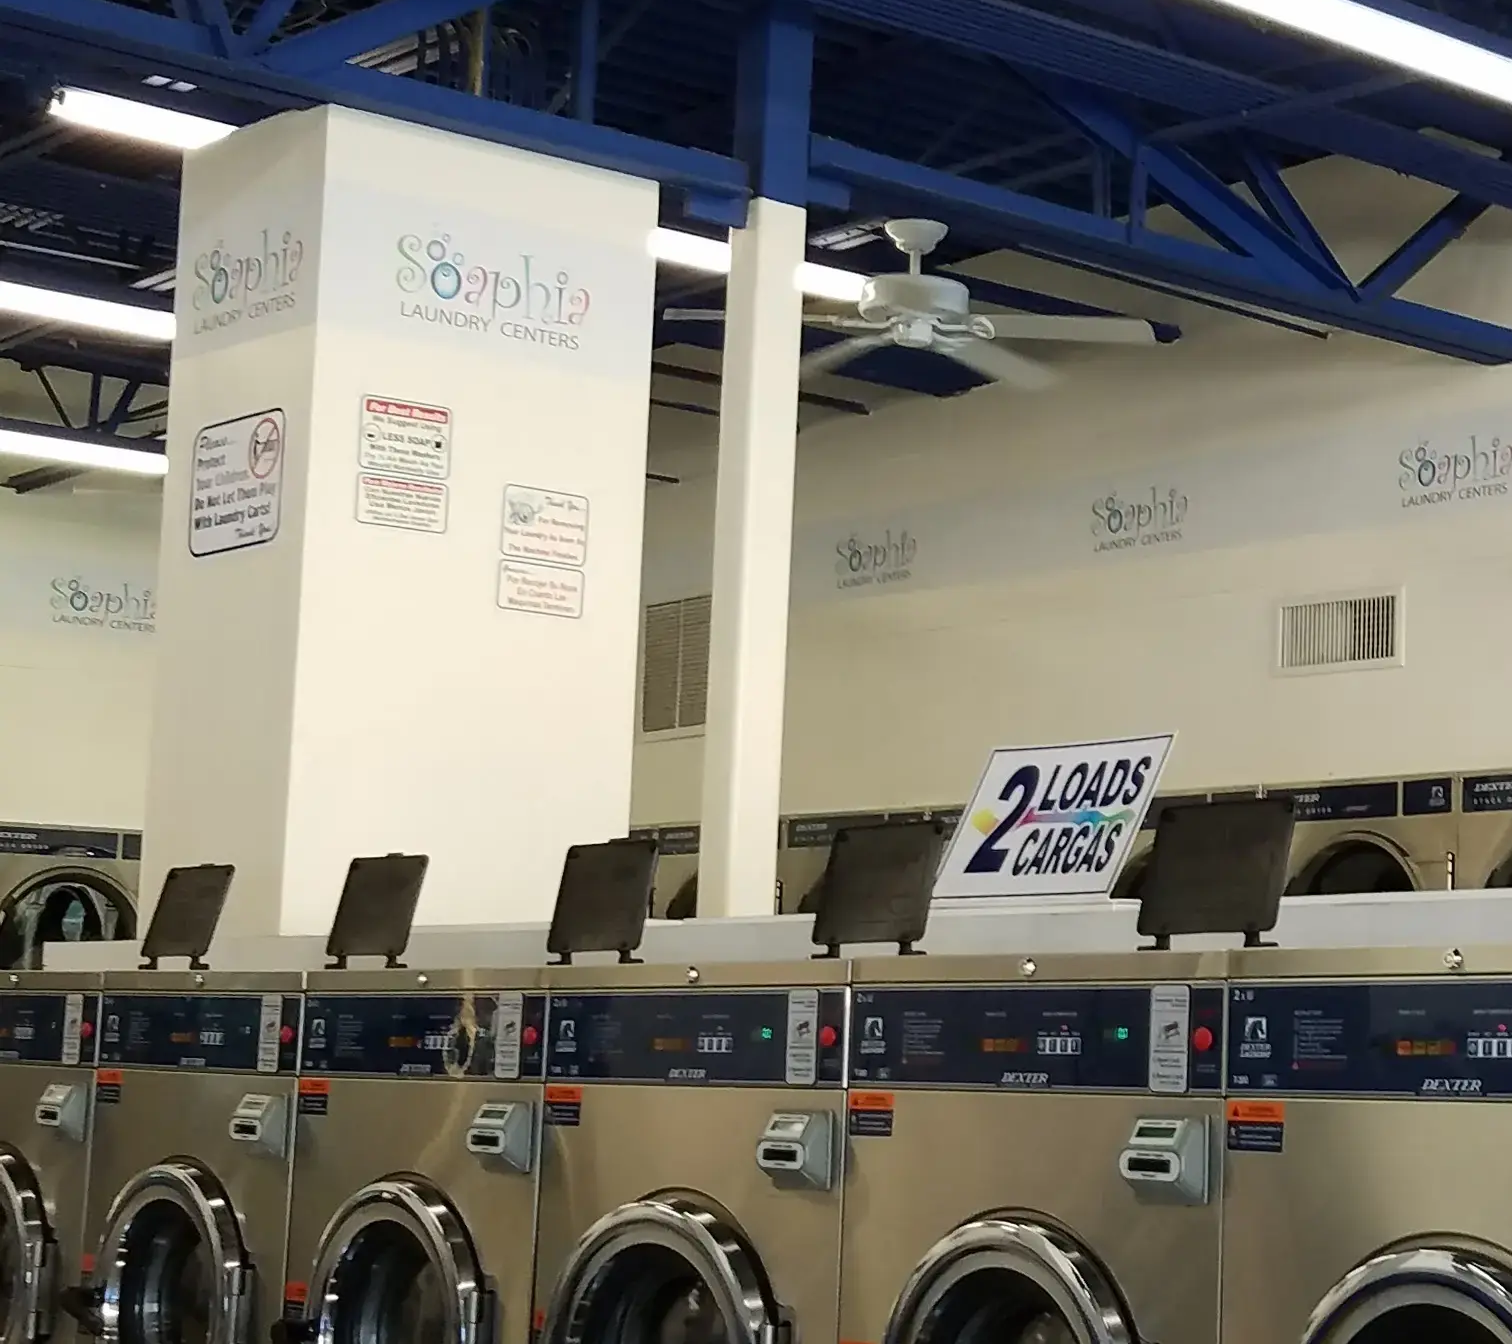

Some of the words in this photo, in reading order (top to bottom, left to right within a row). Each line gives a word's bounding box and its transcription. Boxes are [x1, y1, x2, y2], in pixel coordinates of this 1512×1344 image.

[396, 232, 592, 327] Soaphia
[193, 309, 243, 335] LAUNDRY
[248, 292, 296, 319] CENTERS
[400, 301, 492, 333] LAUNDRY
[500, 321, 580, 351] CENTERS
[1091, 485, 1188, 537] Soaphia
[1402, 490, 1453, 508] LAUNDRY
[1458, 482, 1508, 500] CENTERS
[963, 765, 1041, 874] 2
[1039, 756, 1152, 811] LOADS
[1012, 823, 1122, 876] CARGAS
[1001, 1072, 1049, 1084] DEXTER
[1422, 1078, 1483, 1091] DEXTER
